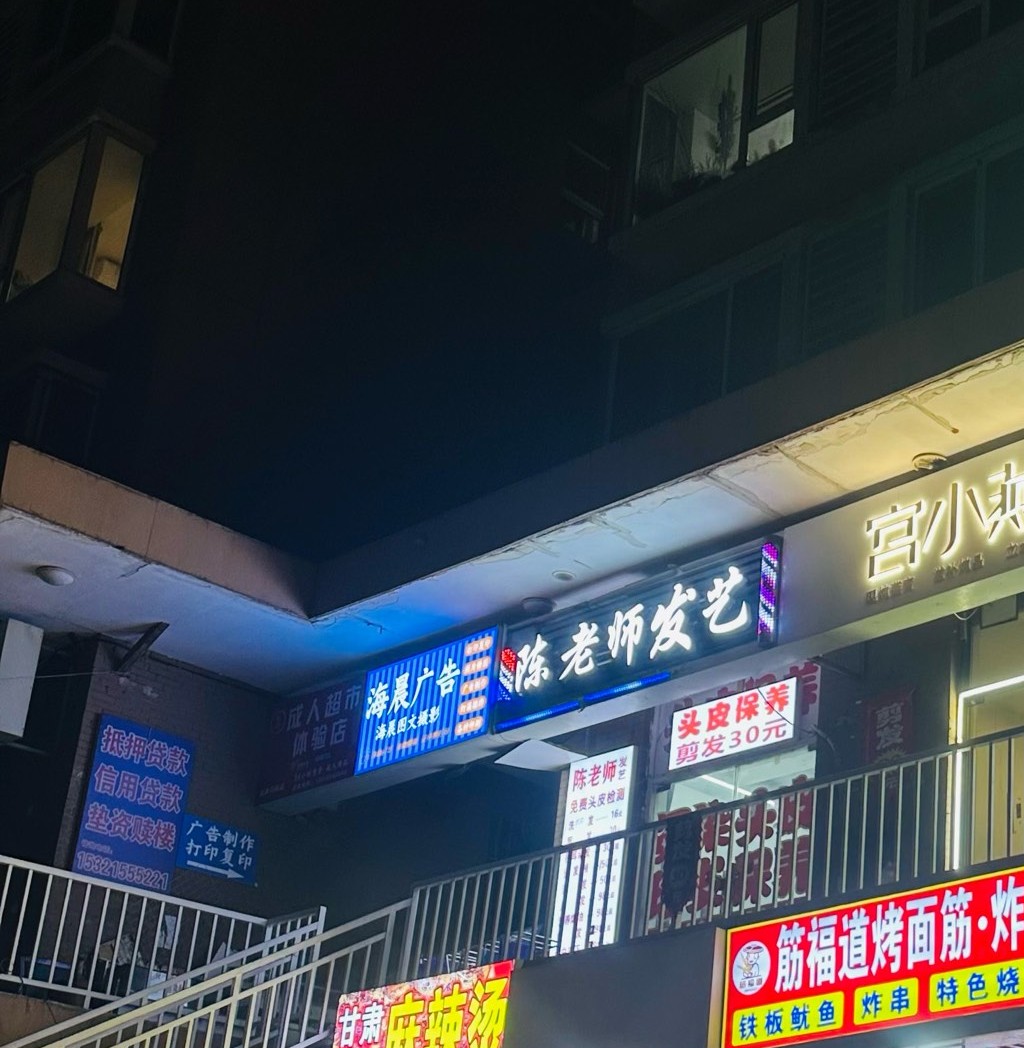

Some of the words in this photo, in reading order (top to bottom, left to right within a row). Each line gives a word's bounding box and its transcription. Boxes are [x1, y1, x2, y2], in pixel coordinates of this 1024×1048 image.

[514, 566, 748, 692] 陈老师发艺
[366, 658, 461, 720] 海晨广告
[678, 683, 791, 740] 头皮保养
[101, 725, 190, 777] 抵押贷款
[676, 715, 788, 766] 剪发30元
[94, 763, 183, 814] 信用贷款
[573, 760, 617, 792] 陈老师
[85, 802, 176, 853] 垫资赎楼
[186, 821, 255, 851] 广告制作
[77, 851, 169, 891] 15321555221
[186, 839, 252, 871] 打印复印
[339, 1002, 385, 1048] 甘肃
[738, 1001, 835, 1041] 铁板鱿鱼
[861, 985, 910, 1017] 炸串
